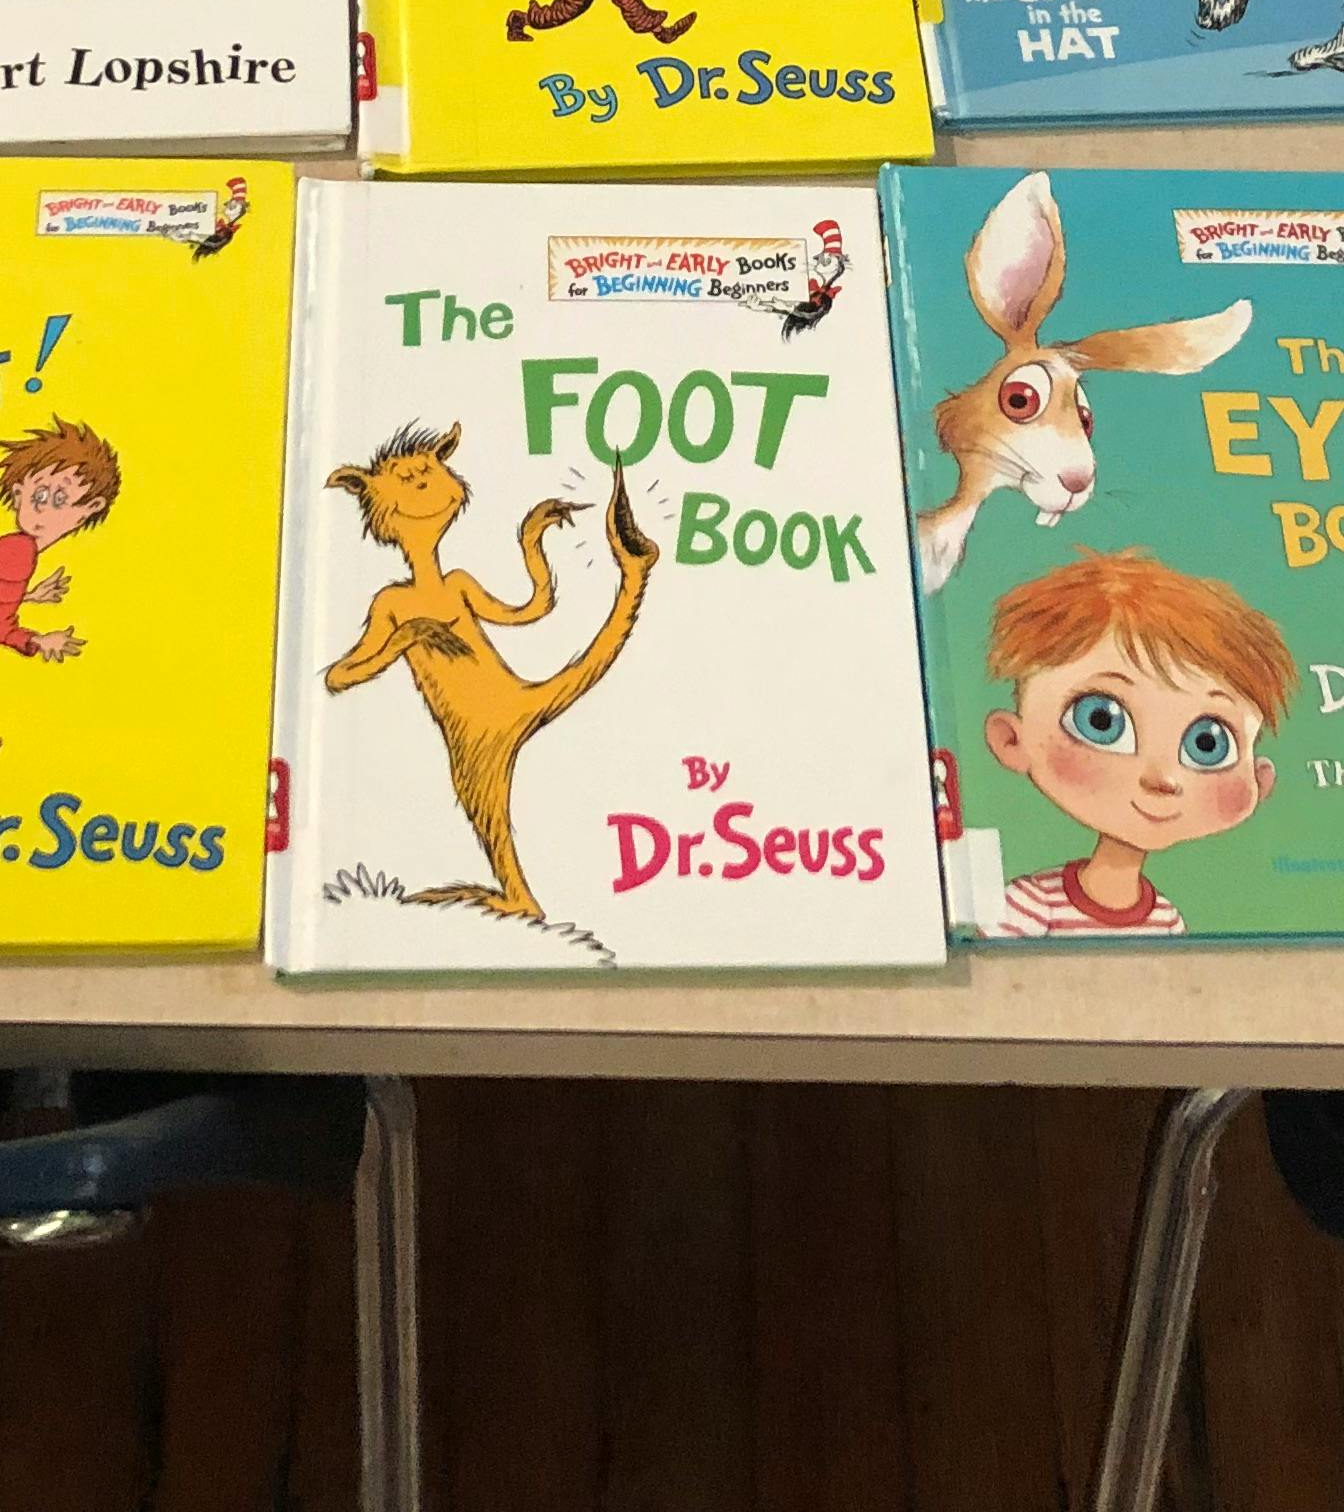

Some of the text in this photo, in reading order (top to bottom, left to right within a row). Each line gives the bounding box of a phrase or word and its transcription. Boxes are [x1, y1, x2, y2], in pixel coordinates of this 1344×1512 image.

[64, 43, 297, 92] Lopshire
[1190, 221, 1259, 244] BRIGHT
[1276, 222, 1331, 242] EARLY
[1196, 249, 1213, 261] for
[1215, 240, 1310, 261] BEGINNING
[564, 251, 796, 278] BRIGHT EARLY Books
[568, 274, 790, 299] for BEGINNING Beginners
[384, 290, 515, 349] The
[520, 356, 830, 470] FOOT
[675, 491, 879, 583] BOOK
[681, 756, 731, 793] By
[606, 802, 885, 896] Dr. Seuss
